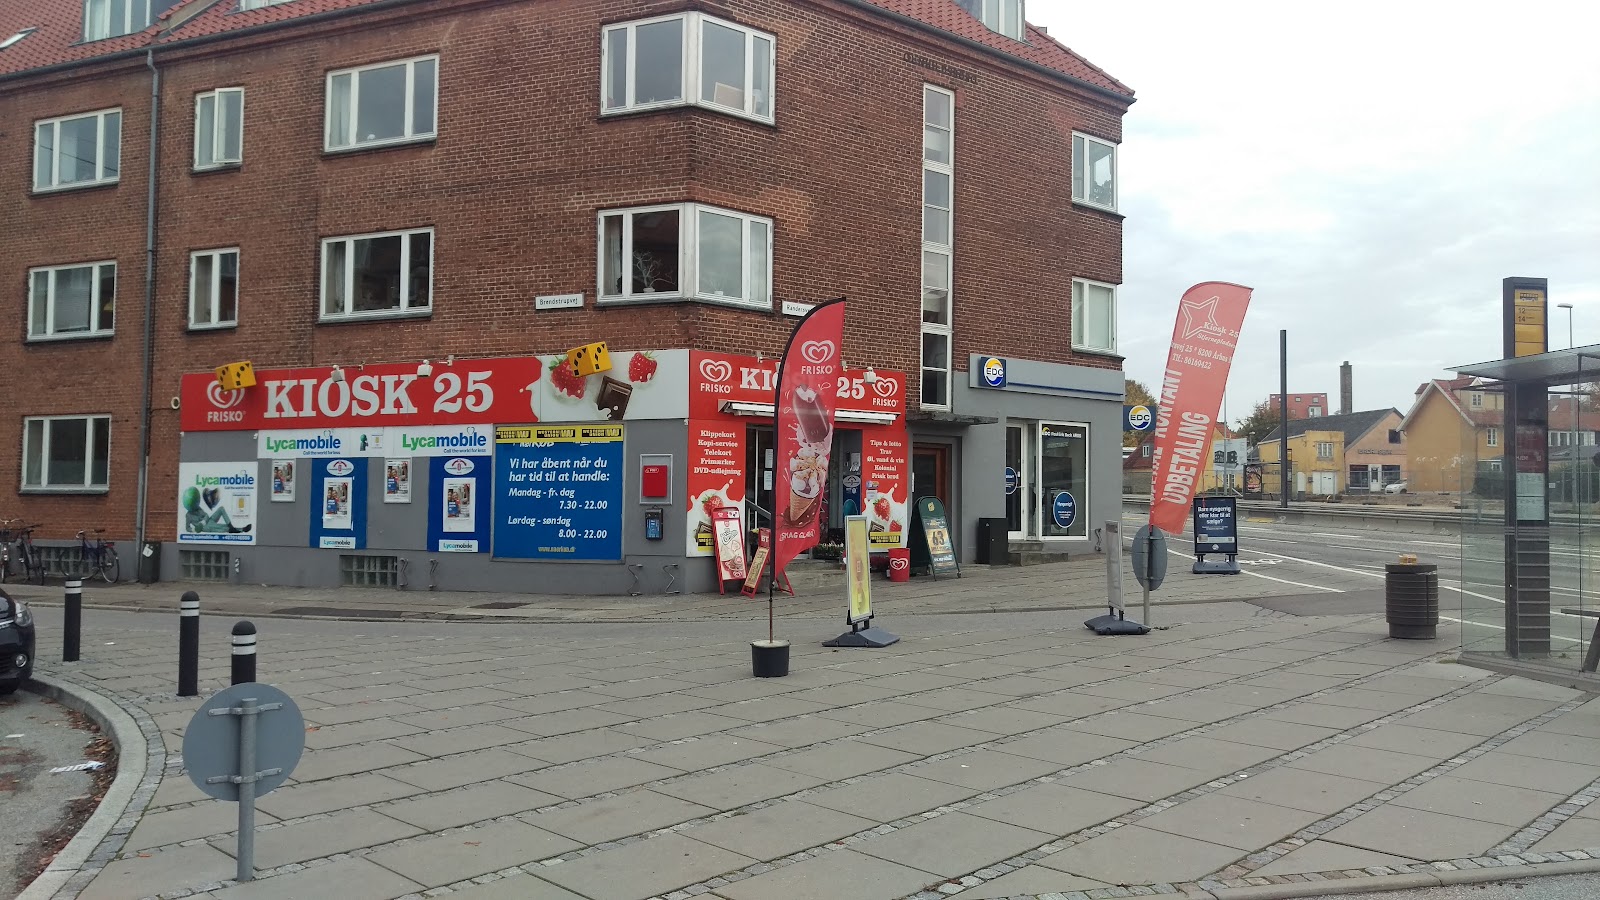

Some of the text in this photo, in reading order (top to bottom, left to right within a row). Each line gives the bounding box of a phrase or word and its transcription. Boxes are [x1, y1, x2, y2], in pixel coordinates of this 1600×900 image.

[1204, 322, 1226, 334] Kiosk
[1198, 348, 1212, 357] 8200
[1213, 350, 1228, 363] Århus
[801, 365, 833, 374] FRISKO
[987, 368, 1003, 376] EDC
[700, 383, 731, 394] FRISKO
[836, 376, 865, 400] 25
[264, 370, 493, 418] KIOSK 25
[873, 398, 897, 407] FRISKO
[207, 410, 244, 423] FRISKO
[700, 430, 736, 438] Klippekort
[267, 436, 341, 452] Lycamobile
[402, 432, 486, 450] Lycamobile
[510, 456, 607, 468] Vi har åbent når du
[1161, 412, 1210, 504] UDBETALING
[509, 471, 610, 481] har tid til at handle:
[694, 467, 741, 476] DVD-udlejning
[196, 474, 254, 487] Lycamobile
[509, 488, 541, 498] Mandag
[559, 501, 577, 510] 7.30
[584, 501, 608, 510] 22.00
[508, 516, 536, 527] Lørdag
[542, 516, 571, 527] søndag
[558, 529, 576, 538] 8.00
[584, 530, 607, 538] 22.00
[932, 530, 944, 545] 63
[324, 538, 350, 546] Lycamobile
